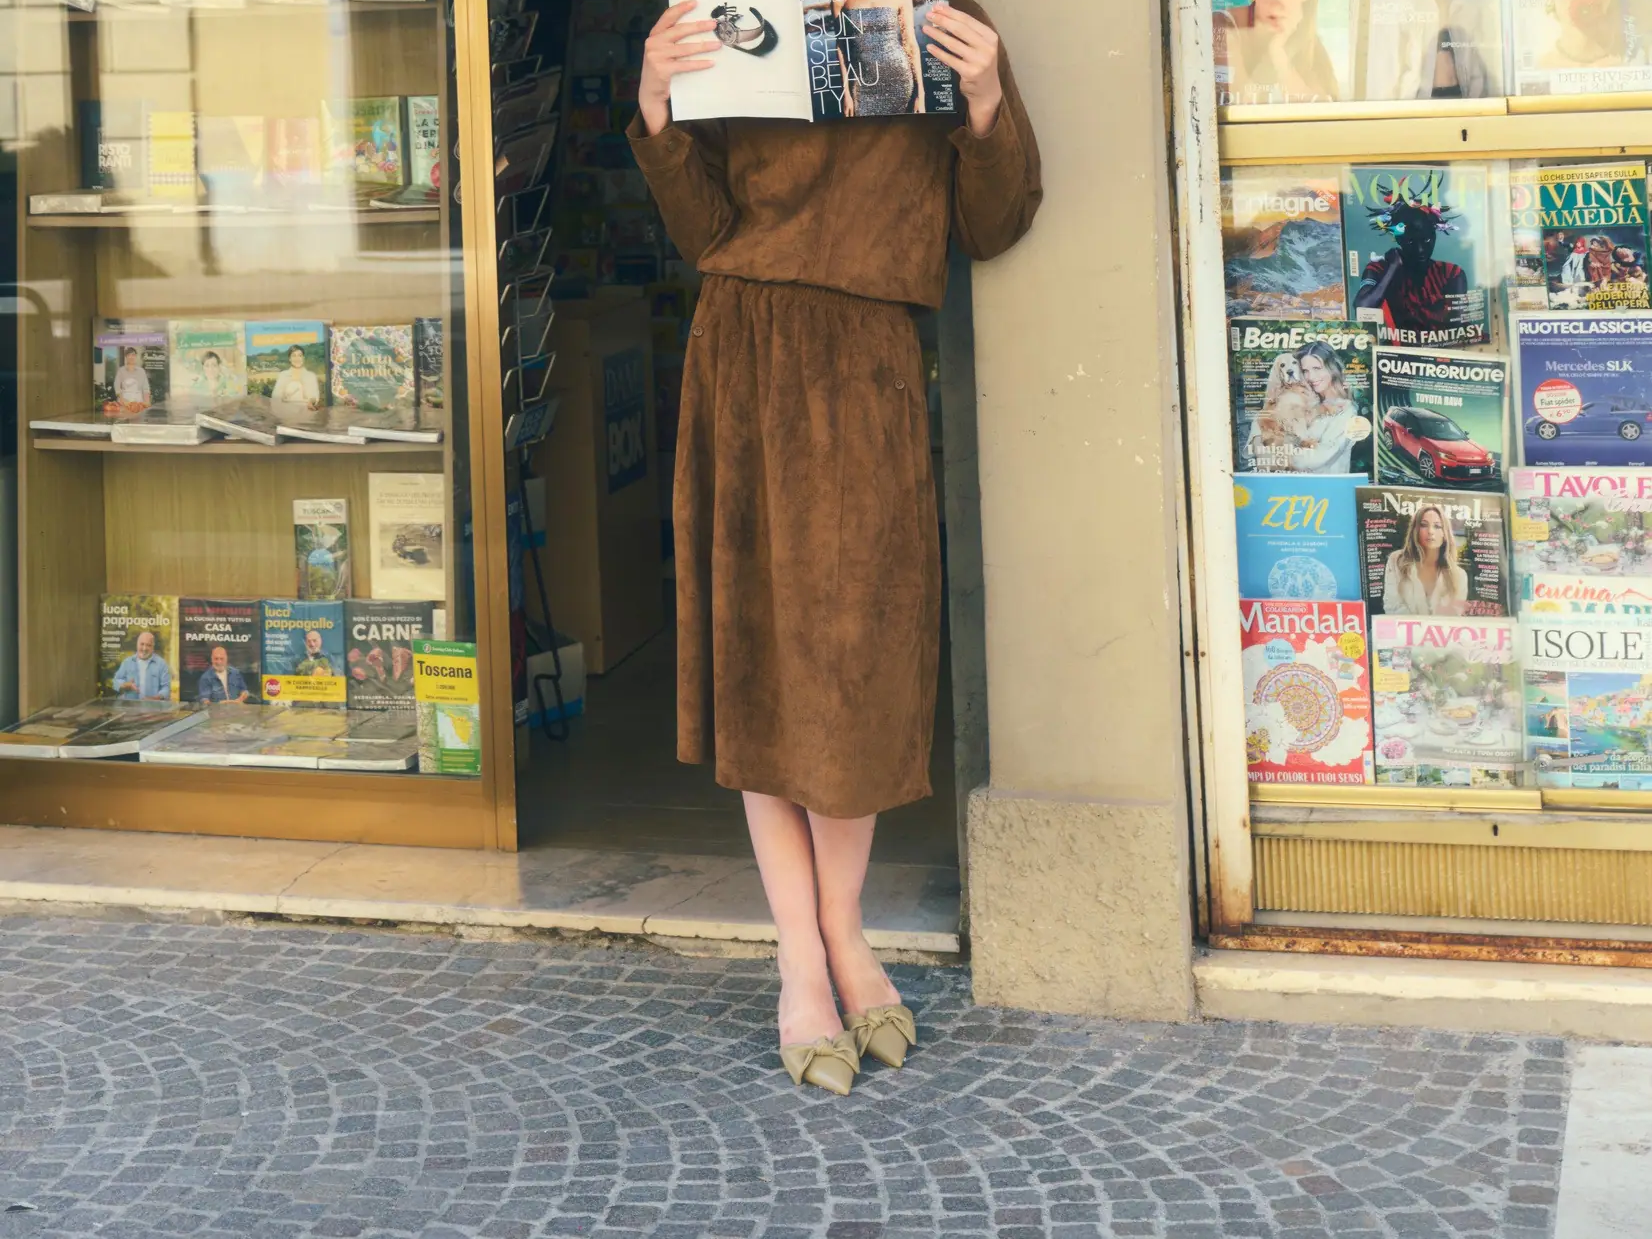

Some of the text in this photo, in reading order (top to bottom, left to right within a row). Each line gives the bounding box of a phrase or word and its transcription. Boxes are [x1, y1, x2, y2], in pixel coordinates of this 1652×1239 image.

[807, 10, 864, 40] SUN
[810, 36, 856, 65] SET
[811, 61, 880, 91] BEAU
[813, 89, 846, 115] TY
[98, 143, 131, 155] RISTO
[98, 154, 132, 169] RANTI
[1550, 173, 1565, 181] CHE
[1566, 172, 1583, 180] DEVI
[1585, 170, 1613, 180] SAPERE
[1614, 169, 1638, 178] SULLA
[1511, 179, 1643, 210] DIVINA
[1511, 206, 1644, 228] COMMEDIA
[1588, 300, 1650, 311] DELL'OPERA
[1243, 327, 1369, 351] BenEssere
[1420, 323, 1484, 344] FANTASY
[1545, 360, 1634, 372] Mercedes SLK
[1415, 393, 1463, 408] TOYOTA RAV4
[1540, 398, 1575, 407] Fiat spider
[609, 411, 644, 476] BOX
[1247, 444, 1314, 457] I migliori
[1247, 455, 1289, 467] amici
[1261, 494, 1329, 535] ZEN
[1464, 520, 1482, 528] Style
[1535, 578, 1614, 602] cucina
[102, 602, 128, 615] luca
[264, 605, 291, 617] luca
[102, 614, 170, 628] pappagallo
[264, 617, 334, 631] pappagallo
[1240, 602, 1363, 634] Mandala
[204, 623, 233, 632] CASA
[1397, 621, 1512, 651] TAVOLE
[1531, 628, 1644, 661] ISOLE
[417, 660, 473, 678] Toscana
[1589, 762, 1626, 772] paradisi
[1265, 771, 1275, 781] DI
[1277, 771, 1308, 782] COLORE
[1317, 773, 1337, 782] TUOI
[1338, 773, 1363, 783] SENSI
